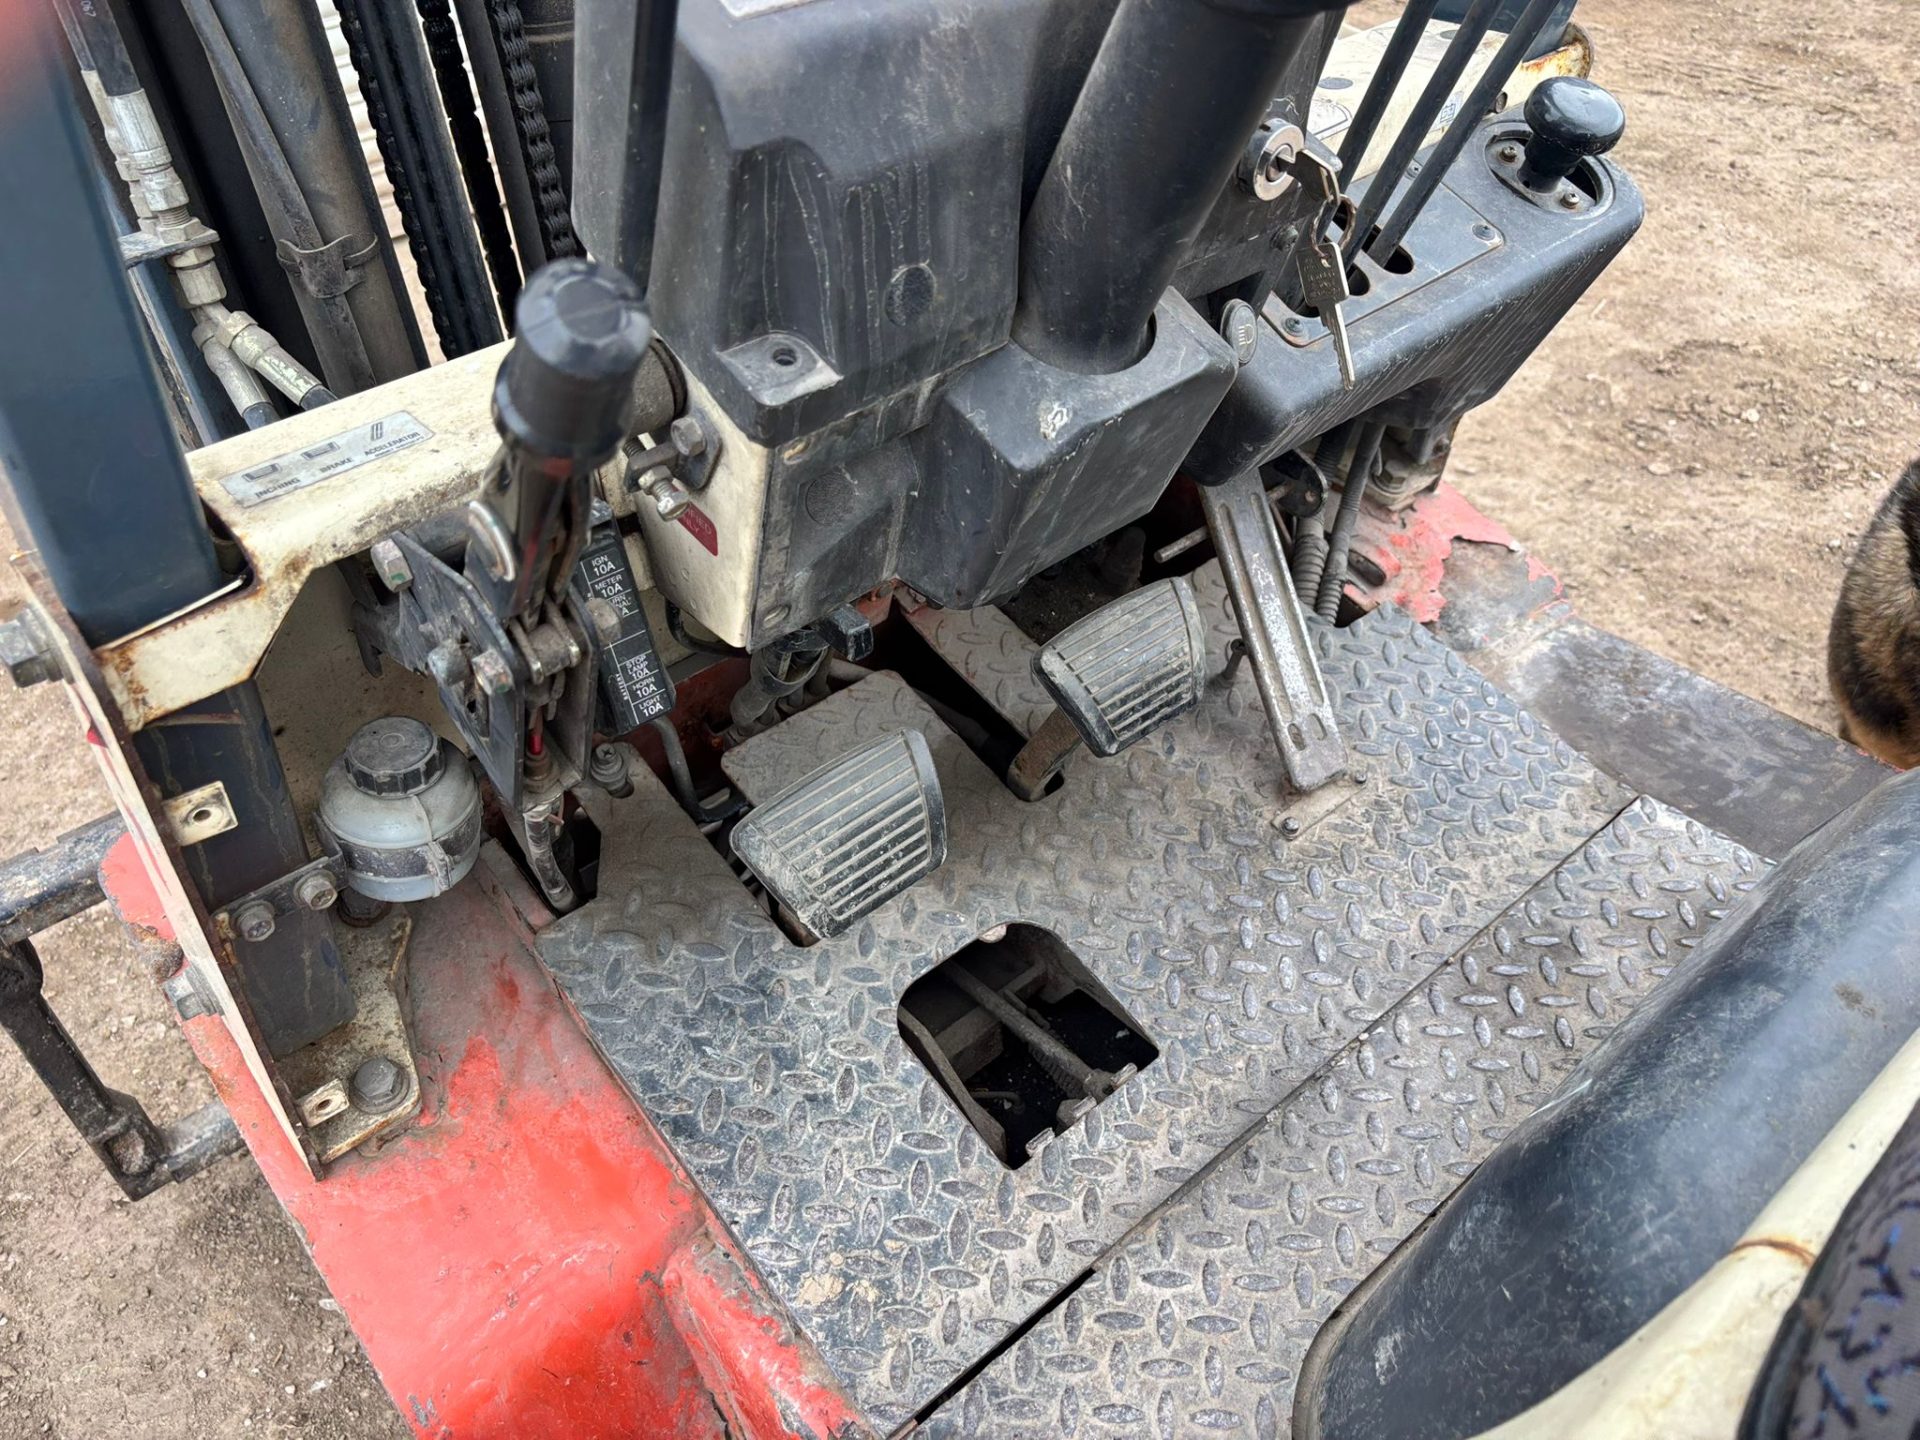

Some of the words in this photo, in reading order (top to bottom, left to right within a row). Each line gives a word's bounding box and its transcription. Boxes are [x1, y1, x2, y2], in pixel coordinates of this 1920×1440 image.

[319, 456, 353, 474] BRAKE
[254, 477, 301, 498] INCHING
[591, 554, 609, 567] IGN
[593, 561, 616, 576] 10A
[594, 574, 623, 591] METER
[601, 583, 623, 598] 10A
[626, 655, 648, 670] STOP
[627, 661, 648, 676] LAMP
[631, 667, 650, 680] 10A
[632, 676, 656, 691] HORN
[636, 684, 658, 698] 10A
[639, 695, 662, 711] LIGHT
[642, 703, 664, 718] 10A
